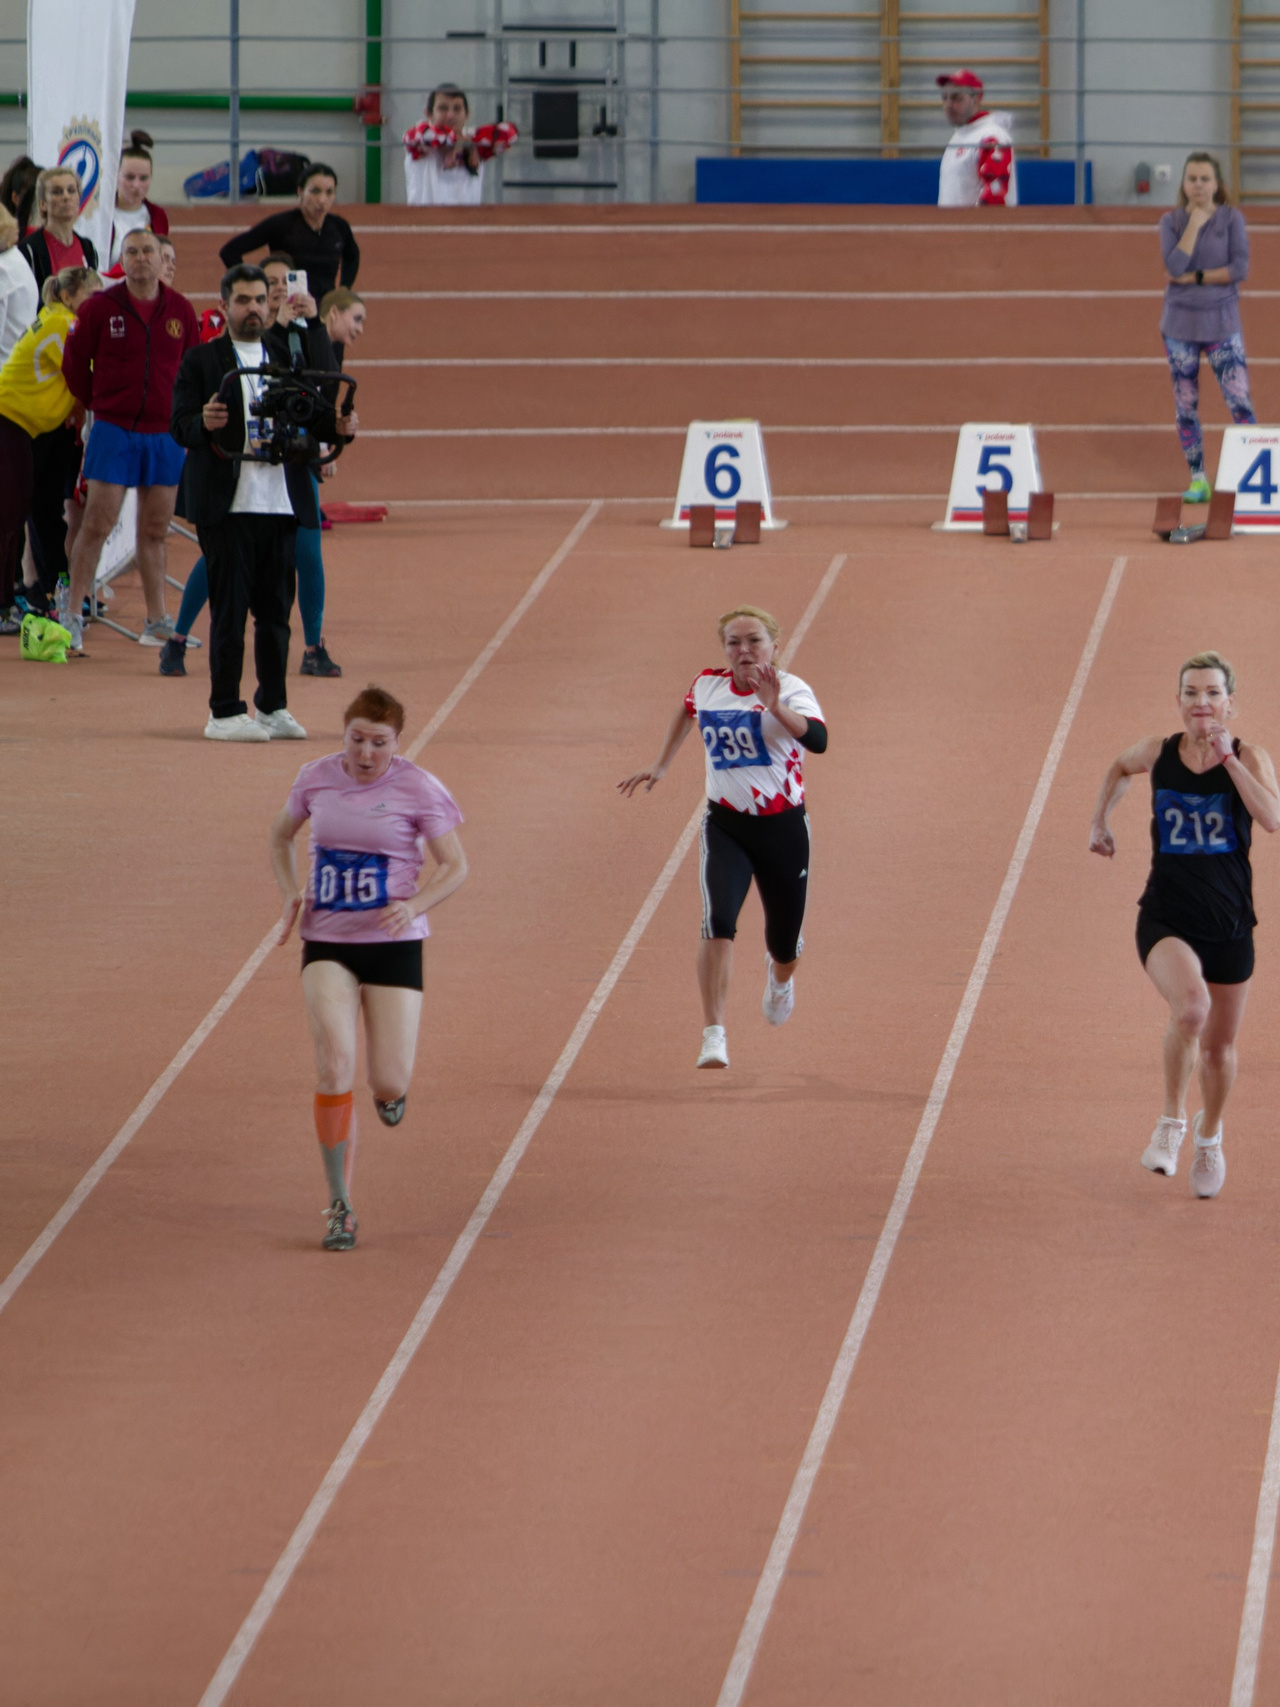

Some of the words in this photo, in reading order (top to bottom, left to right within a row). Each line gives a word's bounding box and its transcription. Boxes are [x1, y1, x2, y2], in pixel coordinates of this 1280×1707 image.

[704, 443, 741, 500] 6
[976, 445, 1013, 499] 5
[1237, 449, 1278, 505] 4
[702, 726, 758, 762] 239
[1164, 808, 1227, 846] 212
[320, 865, 378, 903] 015
